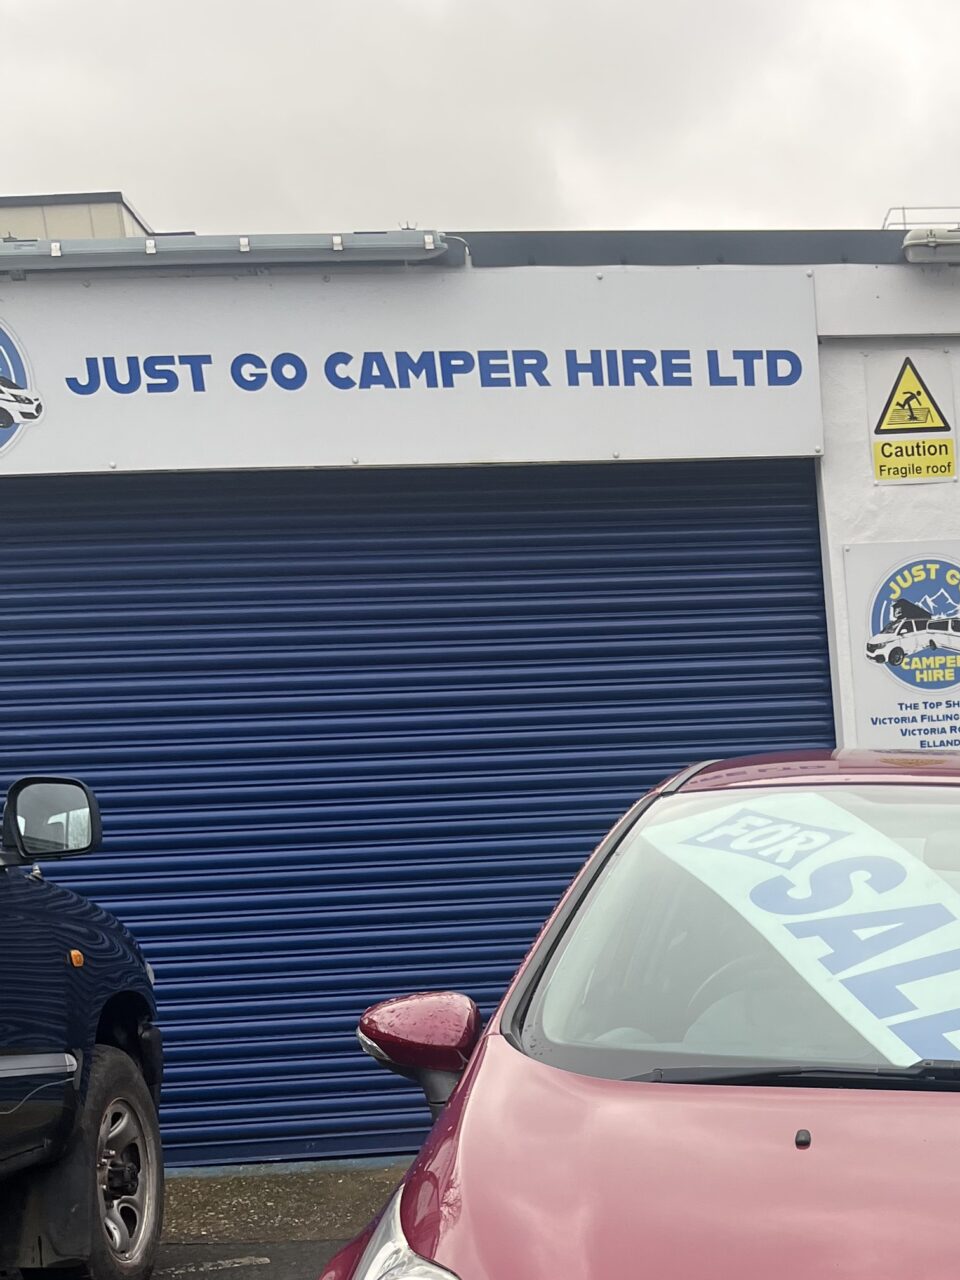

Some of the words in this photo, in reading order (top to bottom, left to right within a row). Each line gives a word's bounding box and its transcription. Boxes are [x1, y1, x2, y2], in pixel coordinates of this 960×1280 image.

[65, 354, 213, 397] JUST
[230, 352, 308, 393] GO
[324, 350, 551, 391] CAMPER
[566, 348, 693, 388] HIRE
[707, 348, 803, 388] LTD
[881, 440, 949, 459] Caution
[878, 463, 922, 478] Fragile
[926, 461, 952, 474] roof
[889, 564, 939, 599] JUST
[915, 669, 955, 682] HIRE
[871, 716, 918, 725] VICTORIA
[900, 727, 947, 736] VICTORIA
[919, 739, 960, 748] ELLAND
[696, 816, 831, 866] FOR
